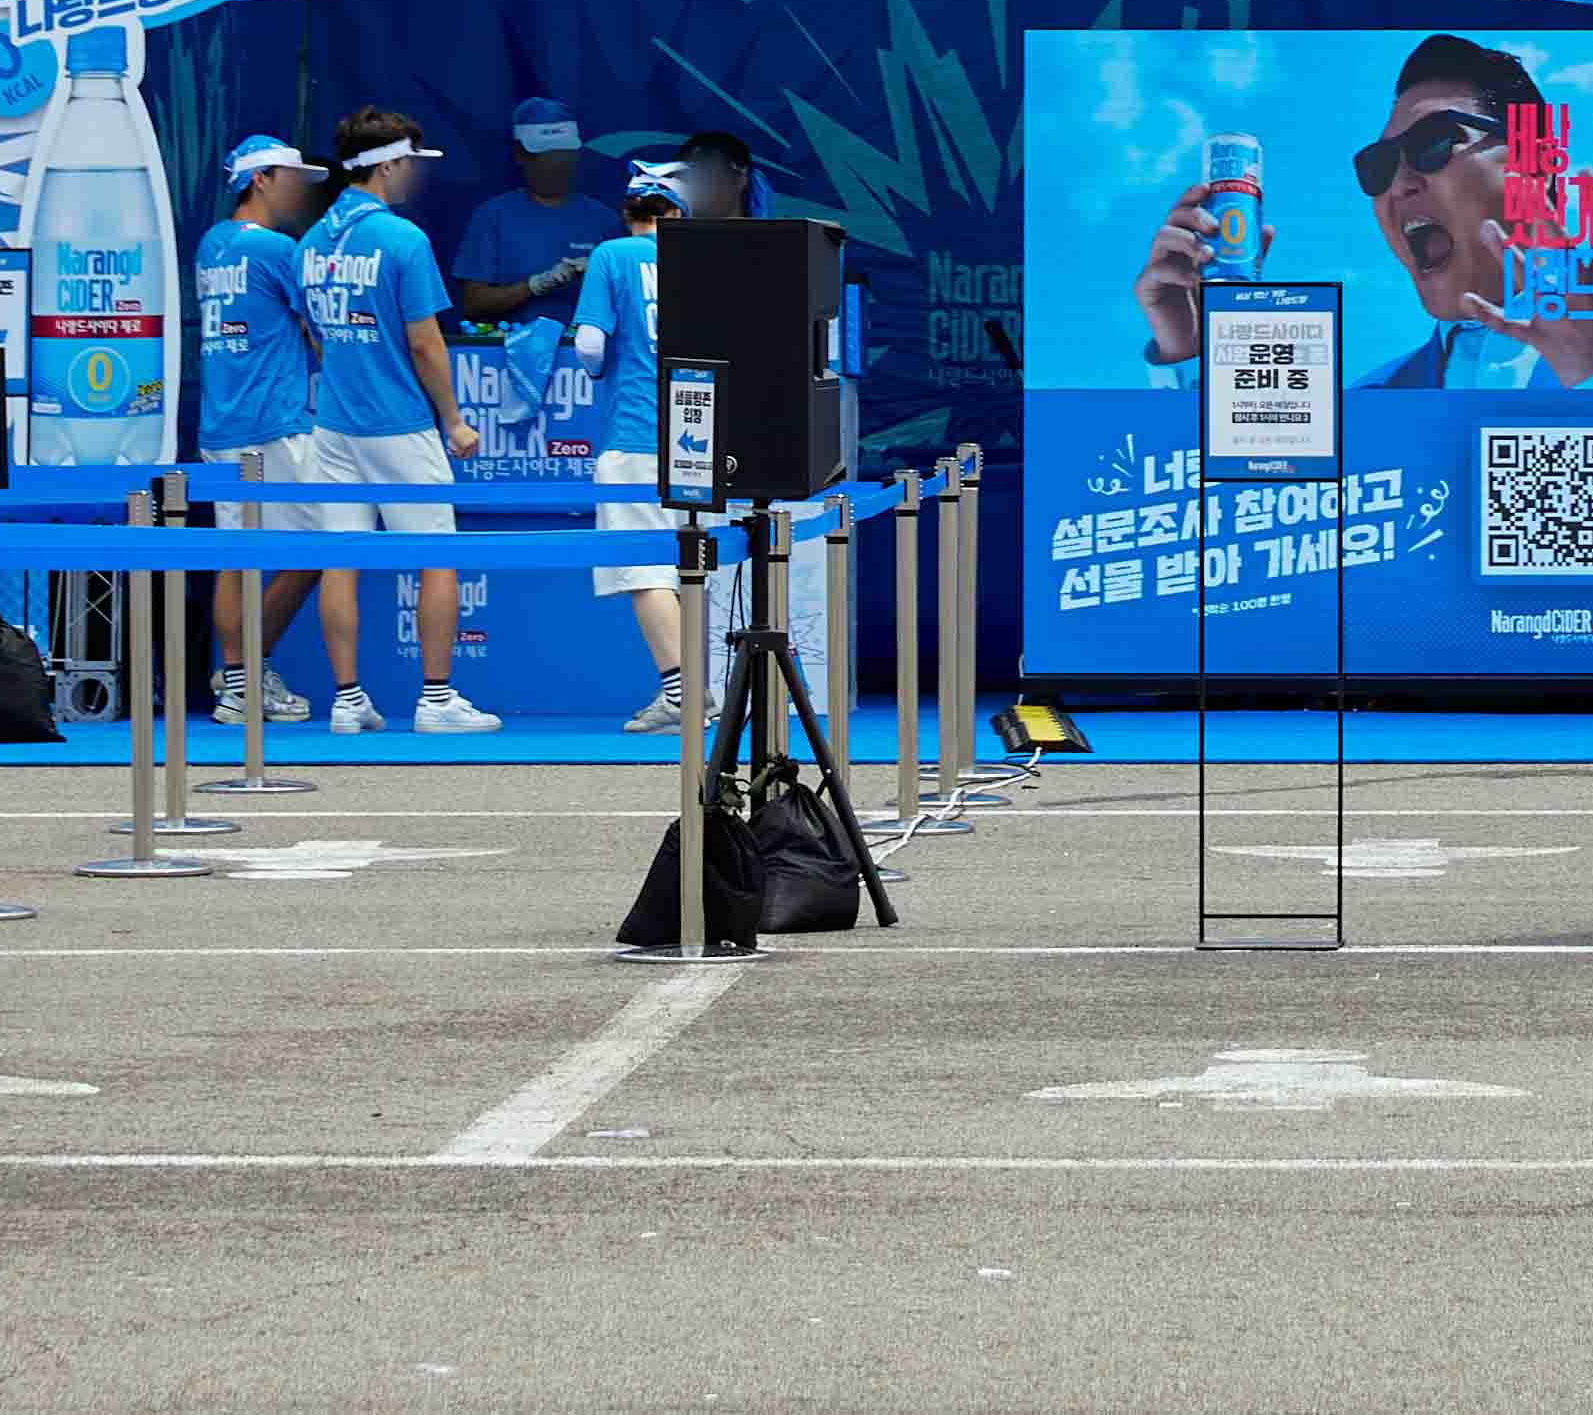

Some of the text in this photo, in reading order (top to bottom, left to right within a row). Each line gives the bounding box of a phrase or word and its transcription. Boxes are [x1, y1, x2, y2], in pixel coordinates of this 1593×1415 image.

[1505, 104, 1570, 174] 세상
[1222, 209, 1245, 244] 0
[58, 242, 142, 284] Narangd
[1249, 343, 1294, 365] 운영
[88, 353, 112, 391] 0
[1235, 369, 1309, 390] 준비 중
[675, 390, 712, 407] 샘플링존
[684, 408, 702, 424] 입장
[552, 443, 589, 455] Zero
[464, 458, 560, 480] 나랑드사이다
[1052, 469, 1403, 560] 설문조사 참여하고
[1059, 521, 1395, 610] 선물 받아 가세요!
